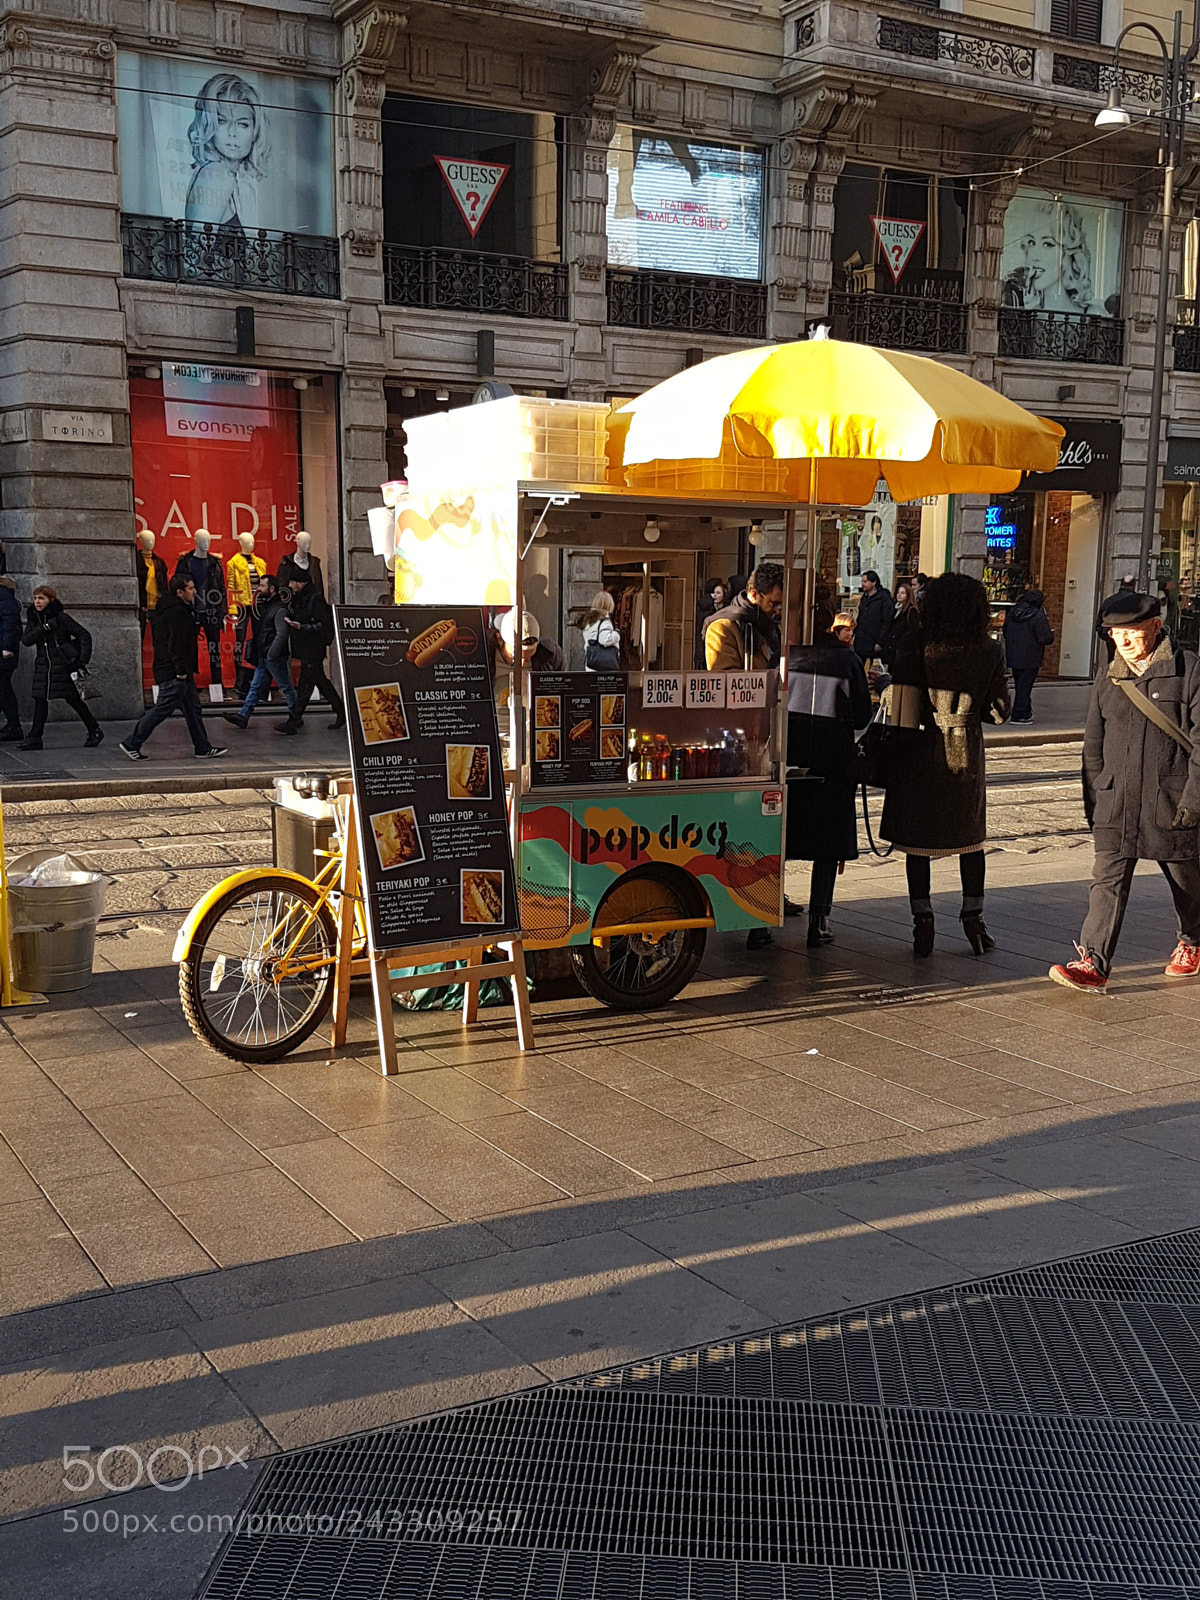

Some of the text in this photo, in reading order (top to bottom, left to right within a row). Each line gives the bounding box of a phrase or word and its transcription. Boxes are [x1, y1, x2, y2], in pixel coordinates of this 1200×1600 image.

[447, 164, 497, 185] GUESS
[637, 210, 680, 224] CAMILA
[879, 222, 916, 239] GUESS
[52, 426, 104, 437] TORINO
[1058, 441, 1093, 464] ehl's
[135, 497, 278, 541] SALDI
[284, 504, 297, 542] SALE
[987, 538, 1012, 548] RITES
[343, 617, 361, 628] POP
[364, 617, 384, 629] DOG
[647, 679, 678, 691] BIRRA
[690, 679, 722, 691] BIBITE
[731, 678, 764, 690] ACQUA
[415, 691, 448, 701] CLASSIC
[450, 690, 466, 700] POP
[647, 691, 674, 703] 2.00€
[690, 691, 717, 703] 1.50€
[731, 691, 756, 703] 1.00€
[362, 756, 384, 767] CHILI
[386, 755, 403, 766] POP
[428, 812, 456, 823] HONEY
[457, 810, 473, 820] POP
[581, 815, 728, 864] pop dog
[375, 879, 412, 892] TERIYAKI
[414, 877, 430, 887] POP
